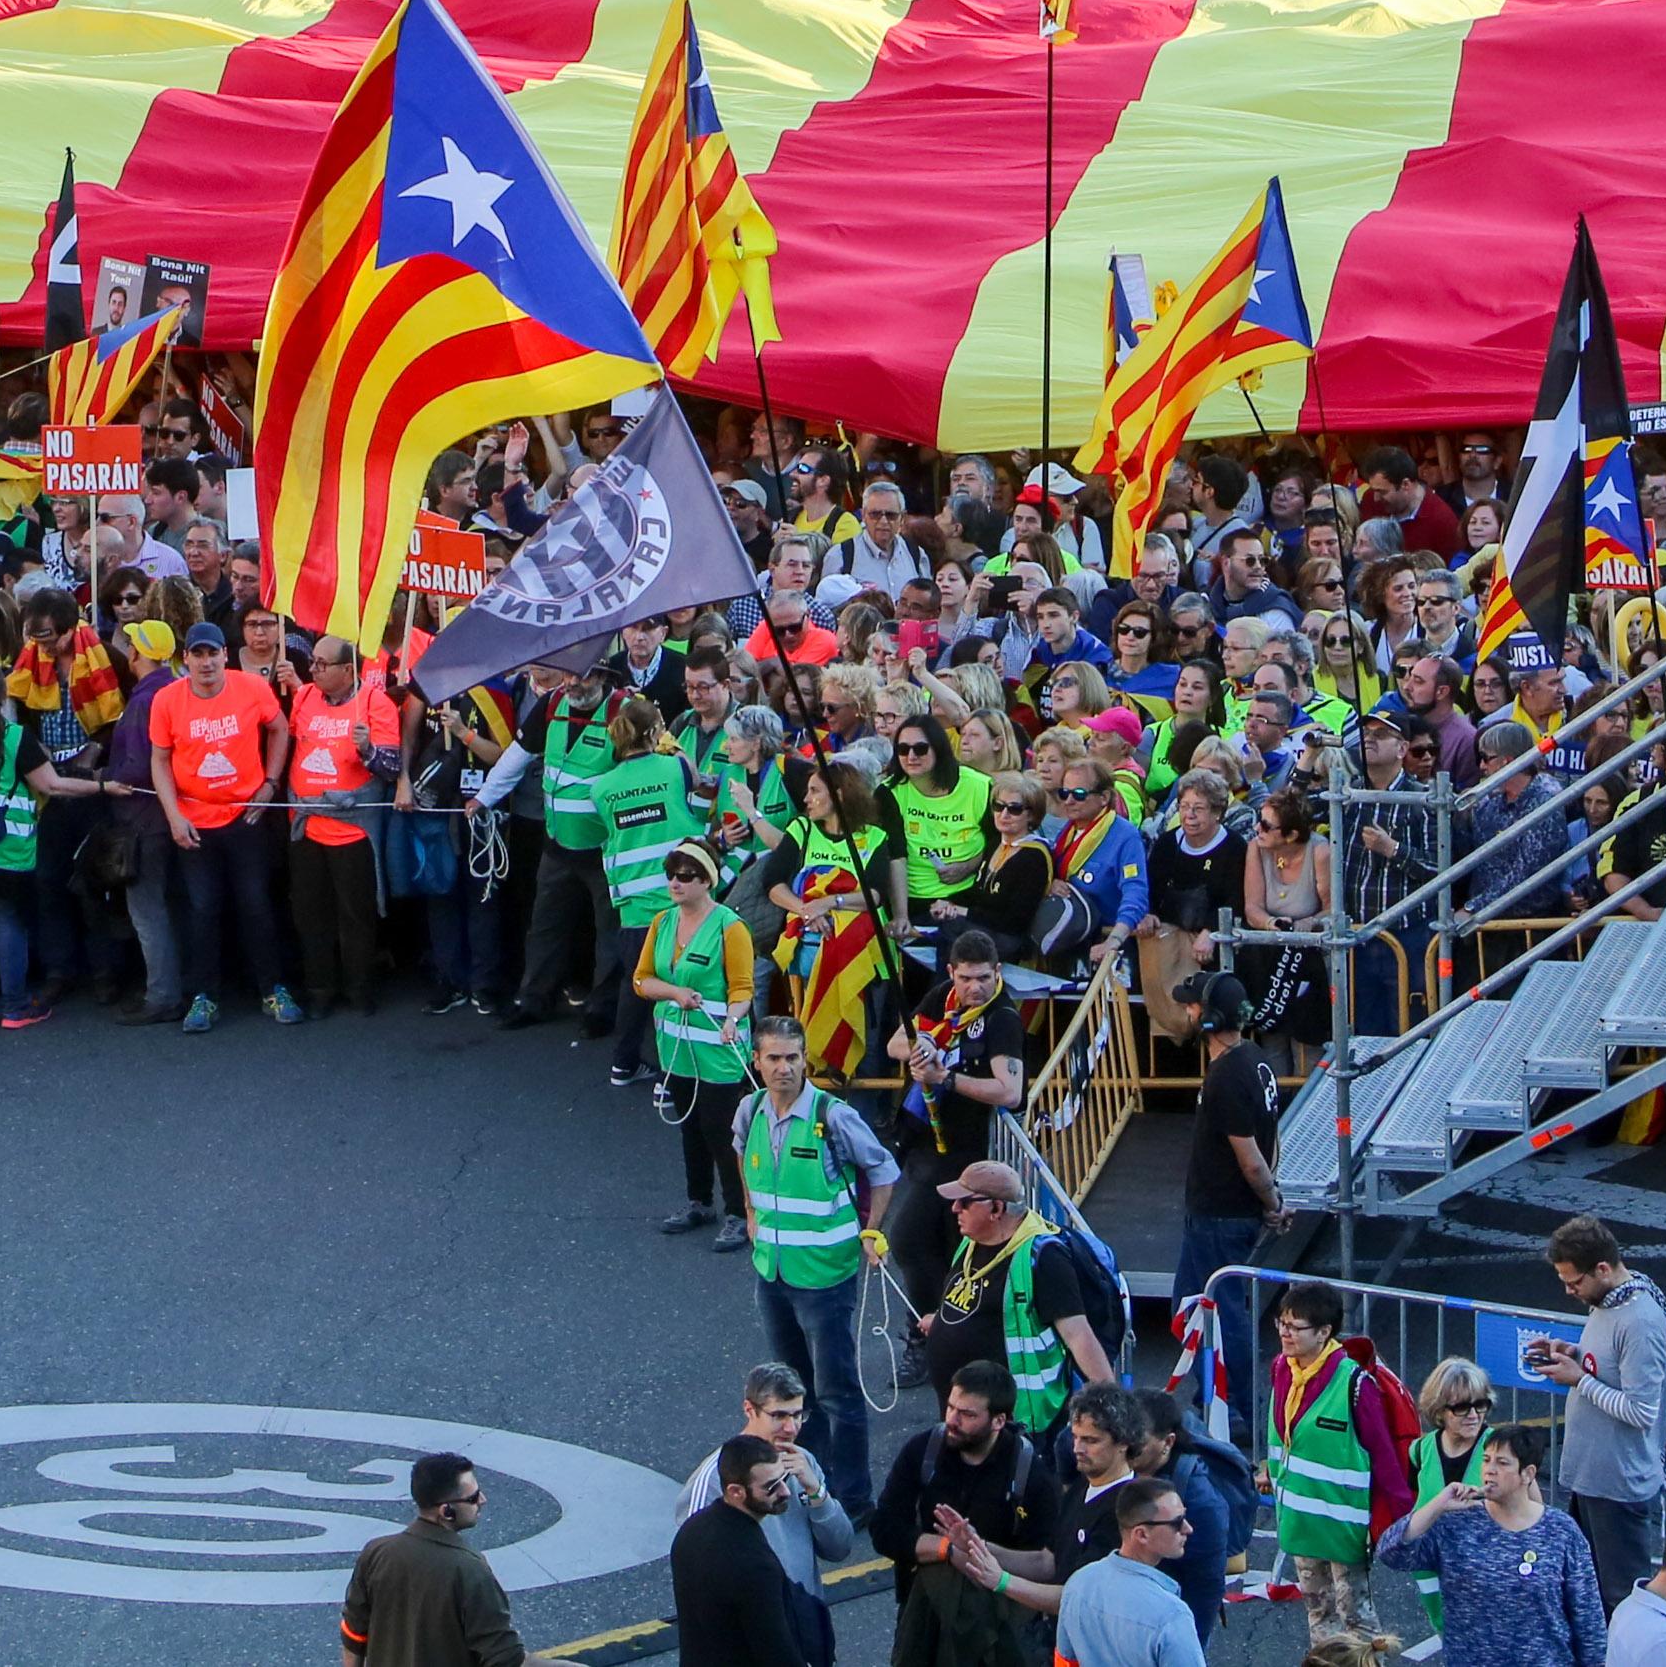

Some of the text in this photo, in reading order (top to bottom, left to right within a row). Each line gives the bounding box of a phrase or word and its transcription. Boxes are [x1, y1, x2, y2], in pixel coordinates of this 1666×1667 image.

[103, 258, 142, 275] Bona Nit
[151, 256, 205, 275] Bona Nit
[110, 272, 132, 286] Toni!
[161, 270, 193, 284] Raül!
[1637, 420, 1652, 433] NO
[1654, 417, 1666, 431] ÉS
[46, 431, 72, 458] NO
[46, 456, 139, 491] PASARÁN
[190, 715, 237, 738] REPÚBLICA
[205, 725, 238, 742] CATALANA
[605, 782, 669, 804] VOLUNTARIAT
[619, 808, 661, 824] assemblea
[907, 807, 925, 820] SOM
[952, 813, 965, 823] DE
[811, 852, 824, 861] SOM
[1272, 976, 1291, 1015] dret,
[1291, 952, 1303, 972] no
